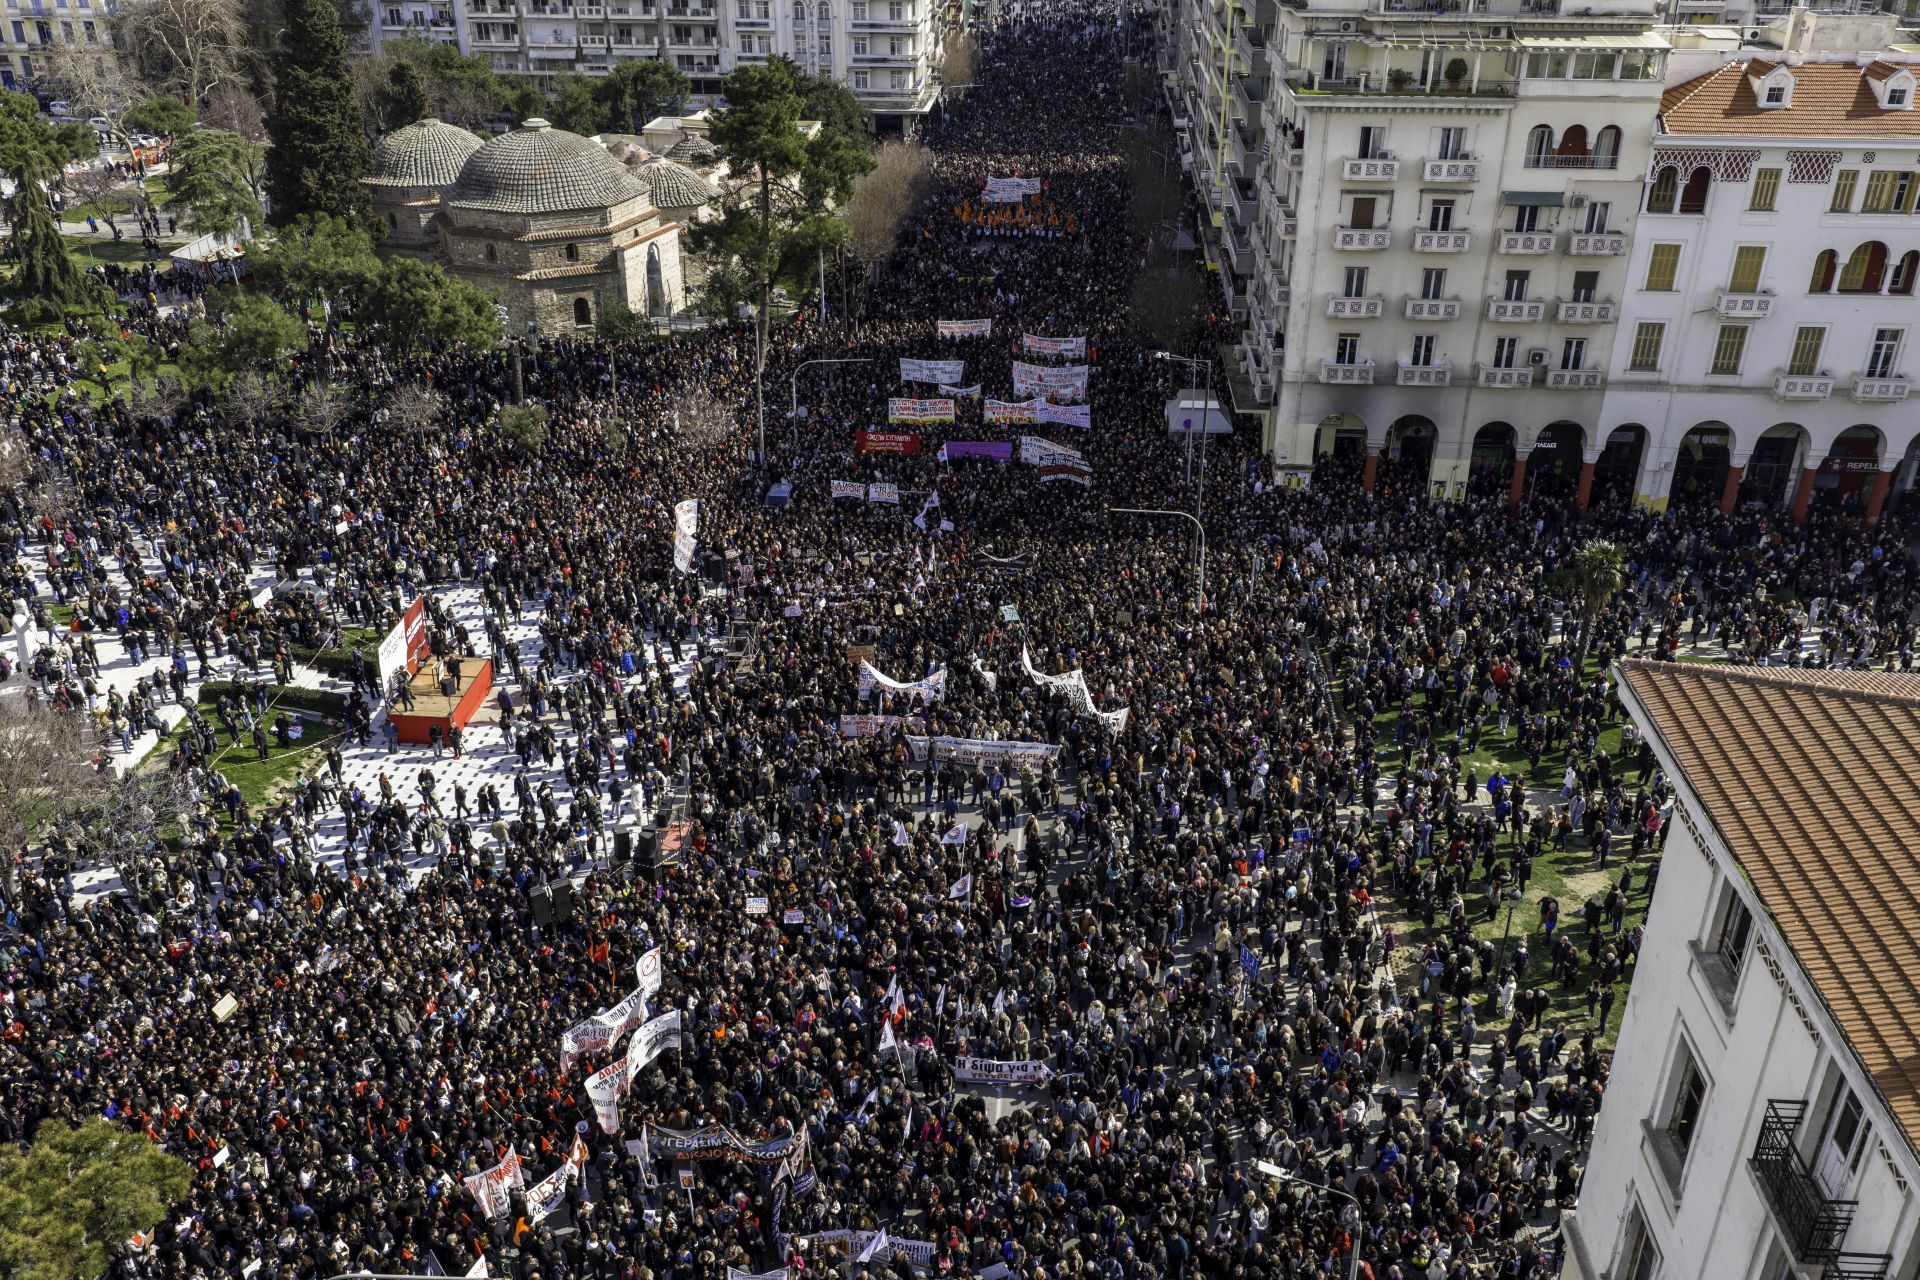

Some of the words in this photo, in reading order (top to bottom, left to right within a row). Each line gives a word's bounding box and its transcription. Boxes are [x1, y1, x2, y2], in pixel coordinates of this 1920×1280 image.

[958, 1060, 966, 1069] Η
[971, 1060, 1004, 1073] δίψα
[1008, 1064, 1028, 1073] για
